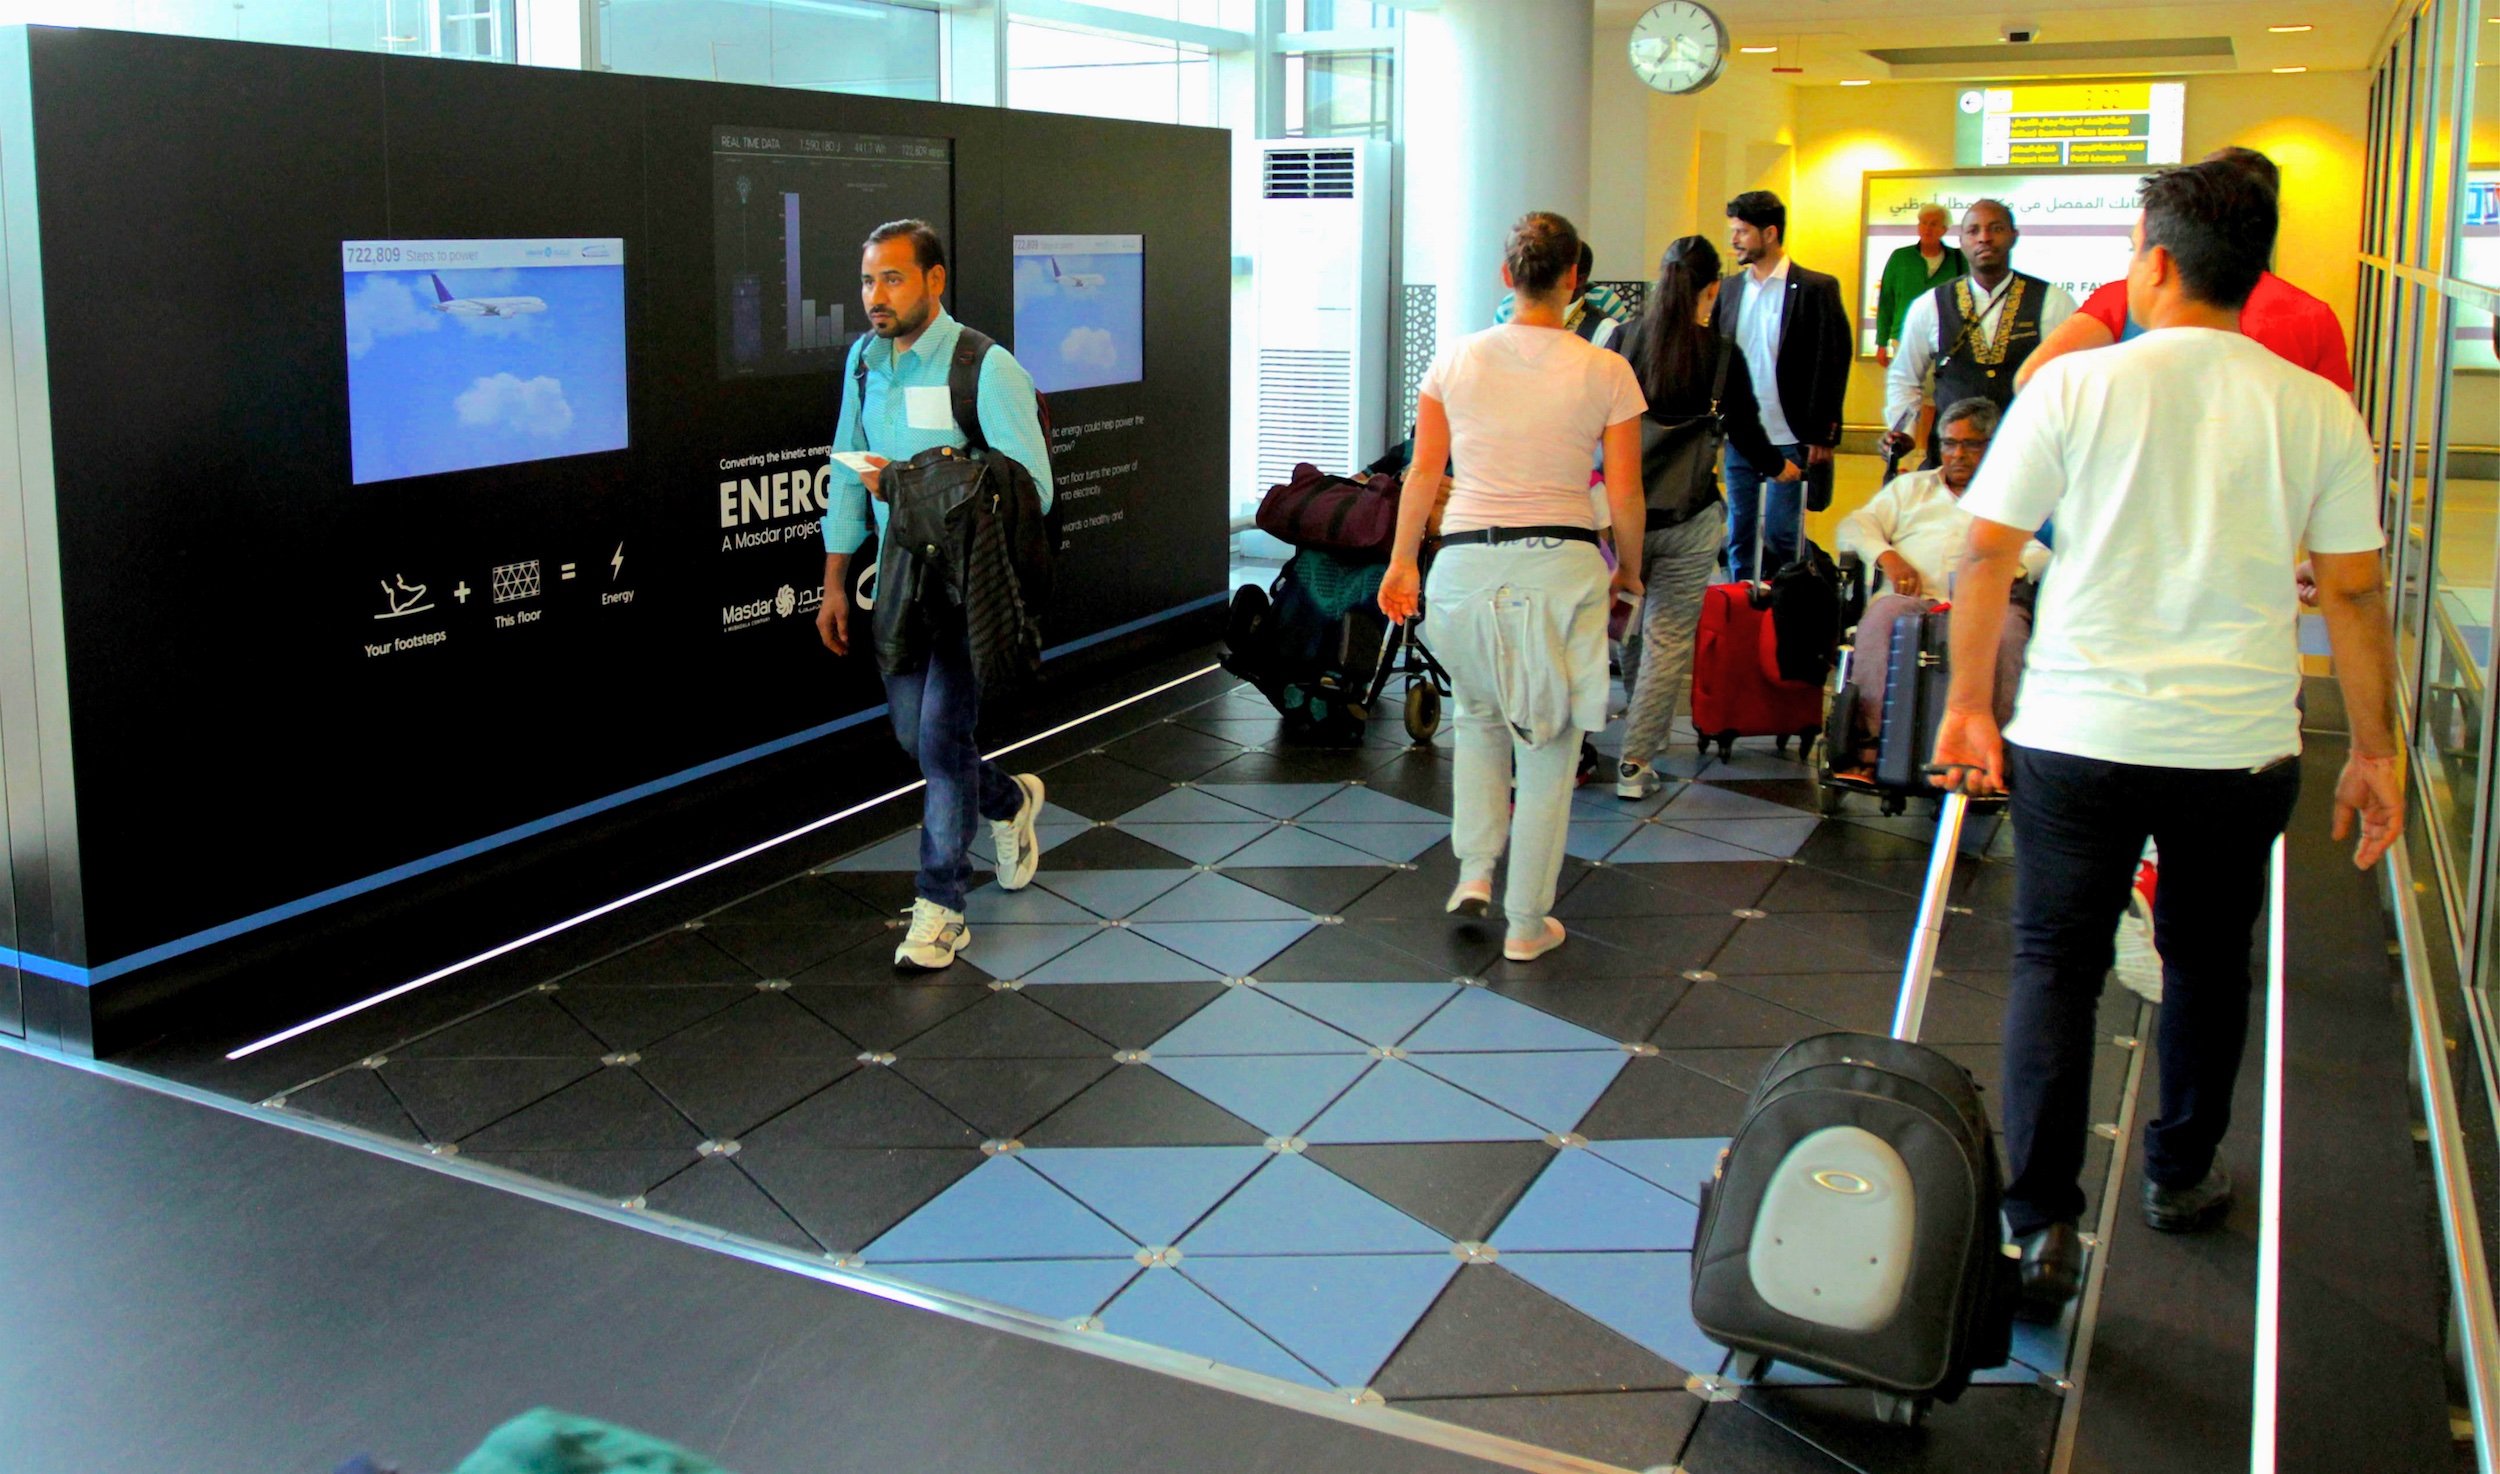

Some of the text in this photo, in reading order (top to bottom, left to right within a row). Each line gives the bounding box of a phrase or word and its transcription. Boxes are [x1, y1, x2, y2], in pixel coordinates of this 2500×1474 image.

[761, 137, 781, 150] DATA
[347, 247, 480, 264] 722,809 Steps to power
[719, 453, 765, 470] Converting
[766, 451, 780, 463] the
[781, 447, 807, 460] kinetic
[721, 535, 733, 553] A
[735, 527, 781, 549] Masdar
[602, 590, 635, 606] Energy
[495, 608, 543, 629] This floor
[722, 598, 773, 626] Masdar
[364, 629, 447, 658] Your footsteps
